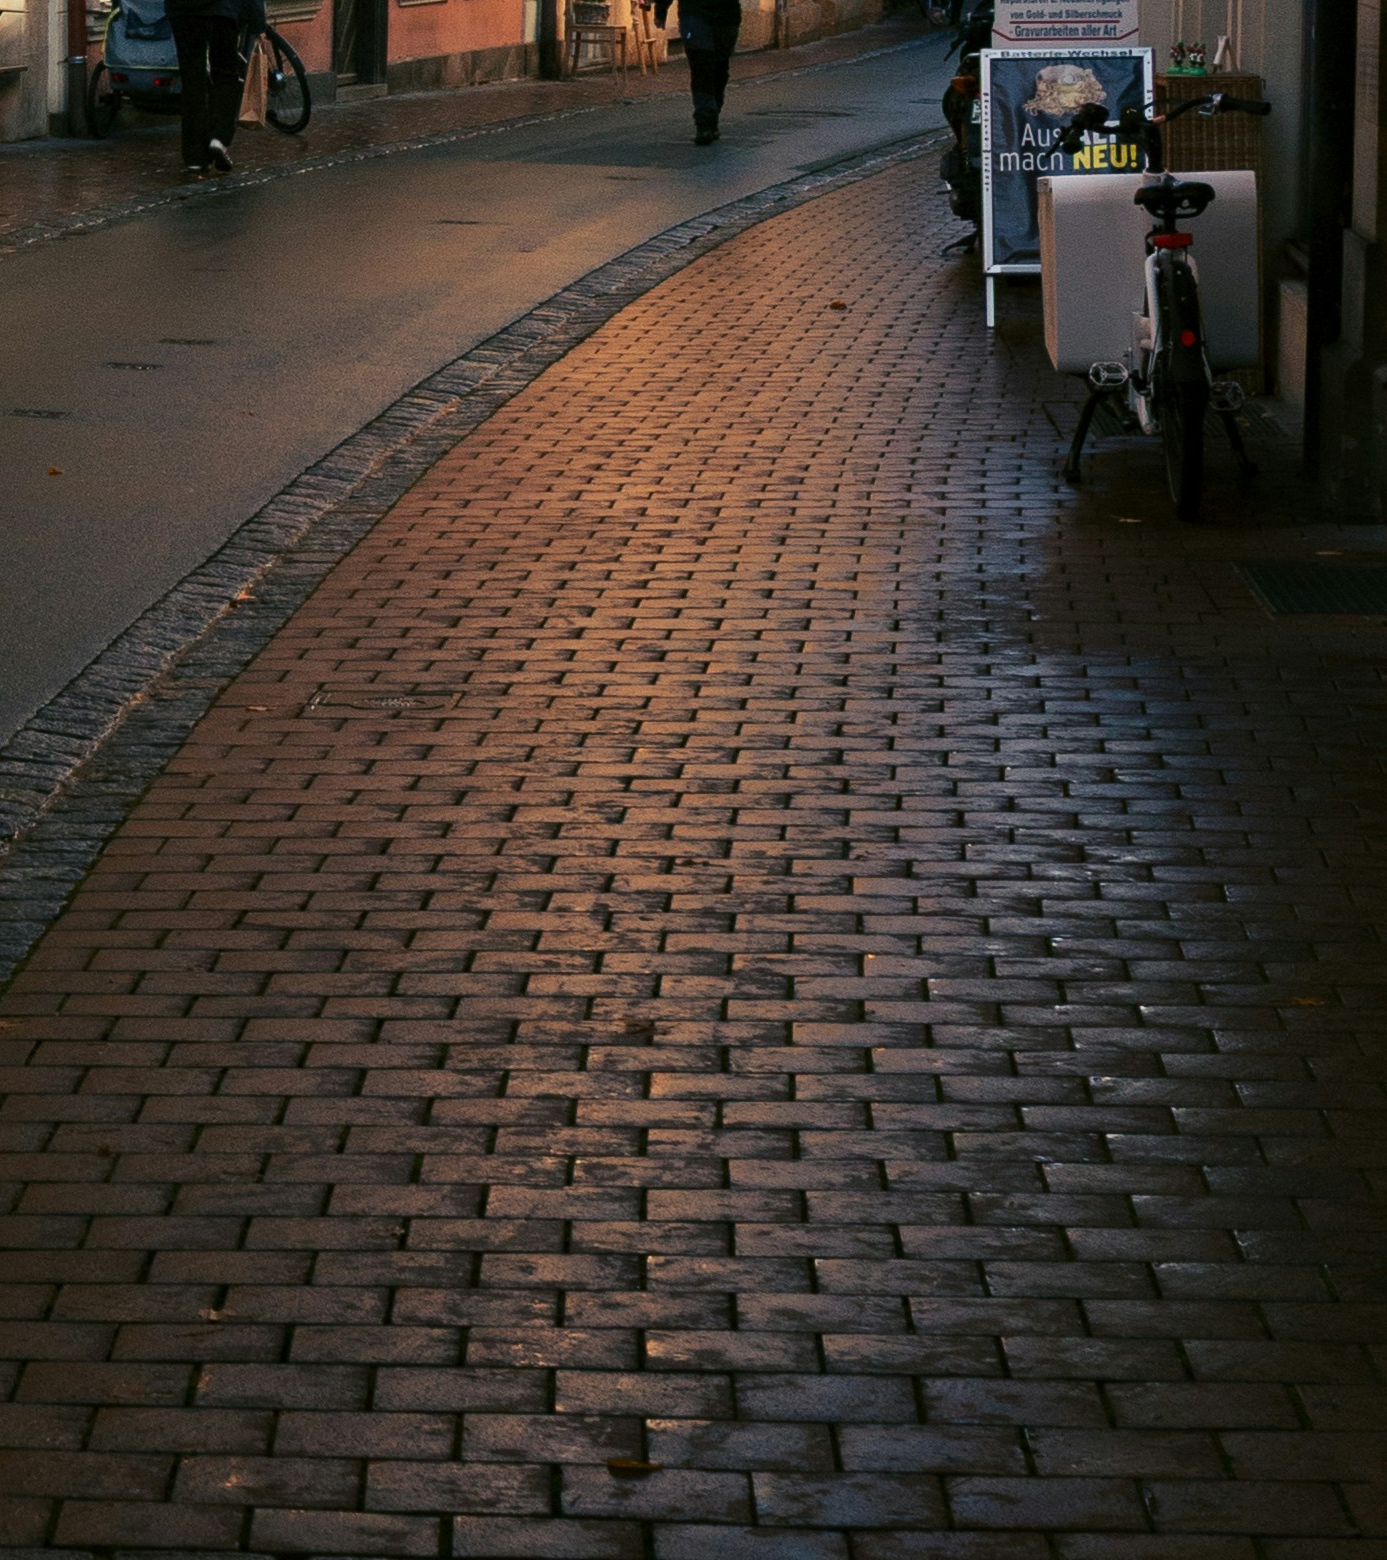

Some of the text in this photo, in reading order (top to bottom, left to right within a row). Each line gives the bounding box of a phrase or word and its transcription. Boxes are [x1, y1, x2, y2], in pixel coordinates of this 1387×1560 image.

[1010, 9, 1123, 19] von Gold- und Silberschmuck
[1014, 25, 1117, 38] Gravurarbeiten aller Art
[1073, 143, 1138, 170] NEU!
